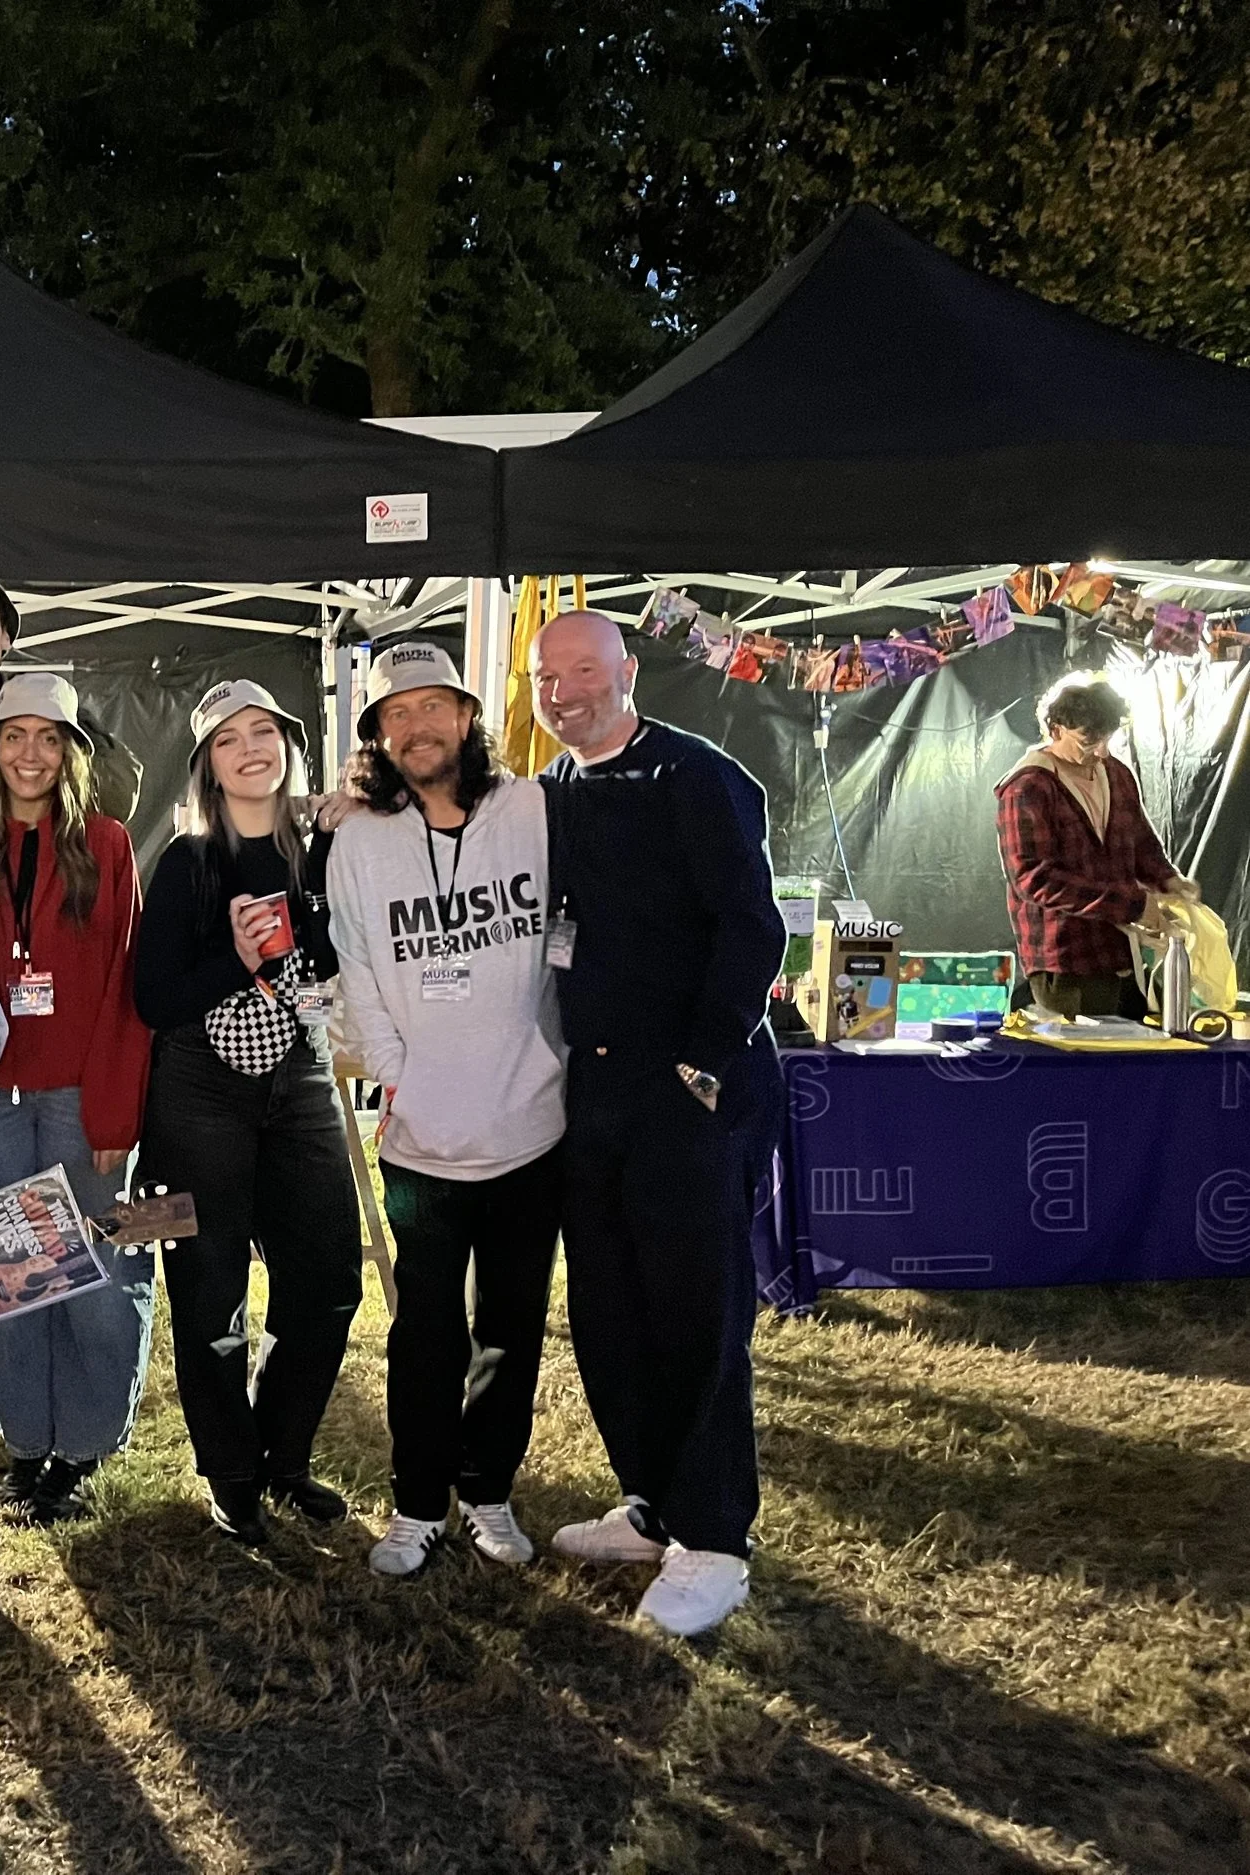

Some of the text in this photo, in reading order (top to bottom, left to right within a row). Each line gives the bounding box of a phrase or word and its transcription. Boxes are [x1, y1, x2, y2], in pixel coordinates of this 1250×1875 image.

[389, 872, 539, 937] MUSIC
[392, 913, 543, 963] EVERMORE
[833, 920, 902, 938] MUSIC
[422, 969, 458, 980] MUSIC
[4, 1195, 42, 1257] CHANGES
[48, 1198, 74, 1233] THIS
